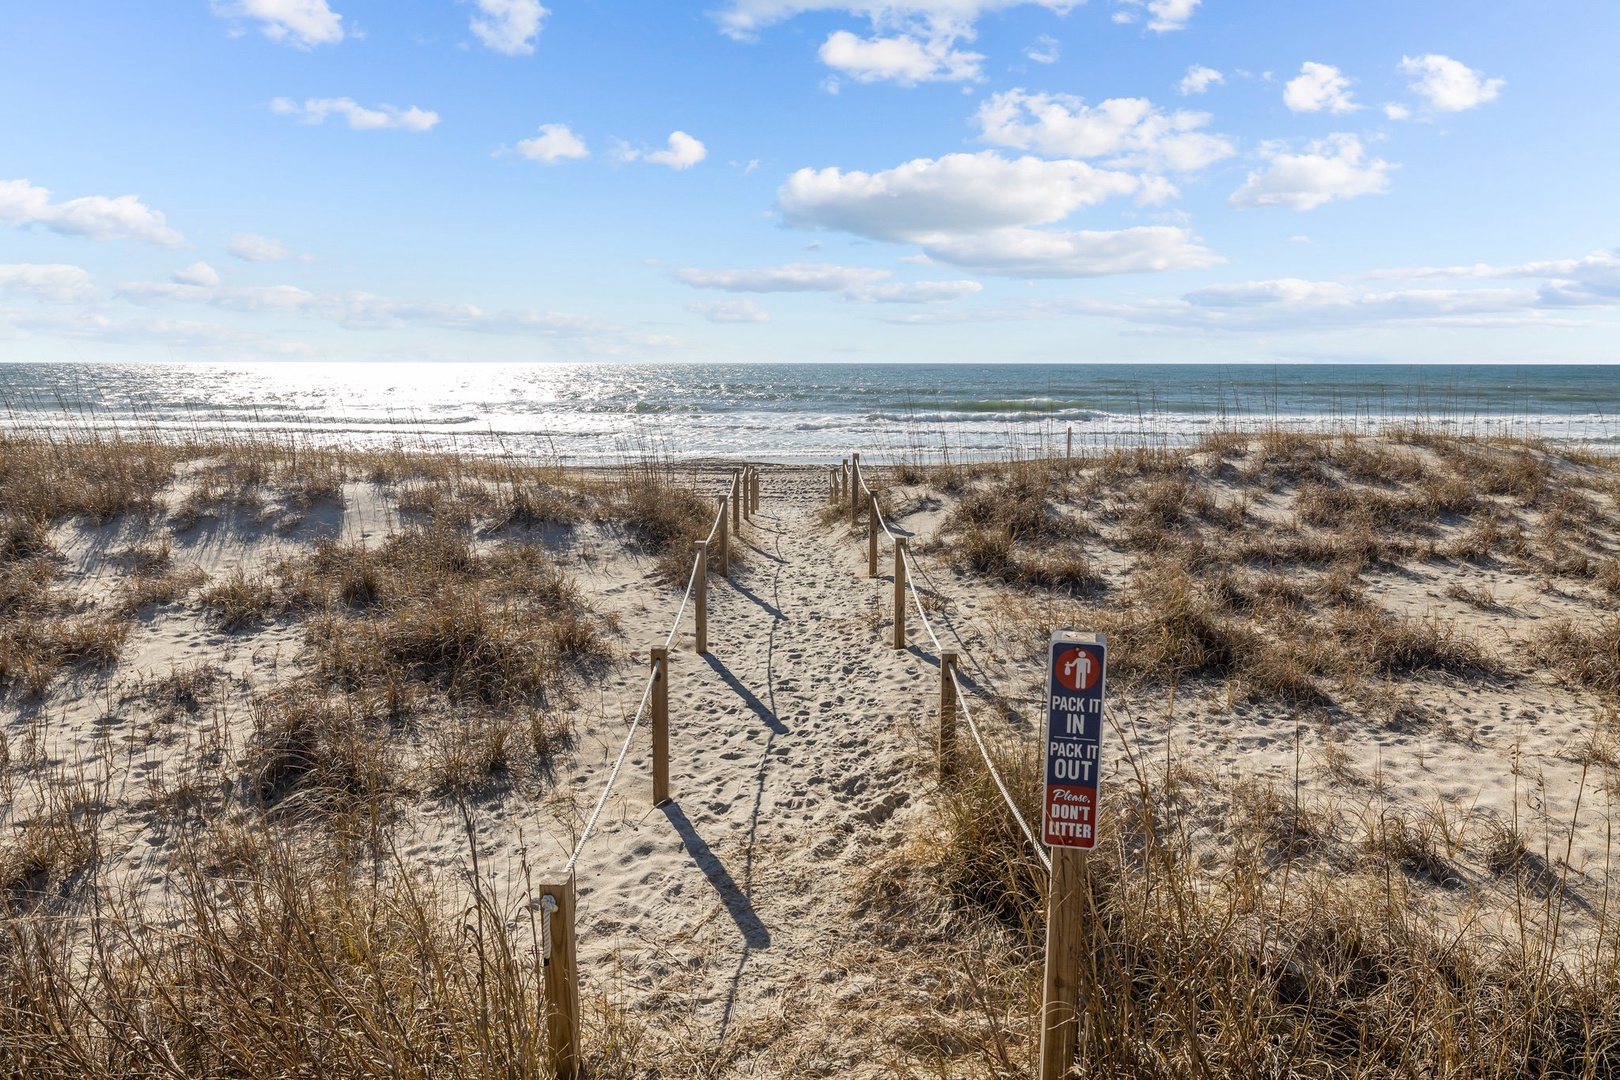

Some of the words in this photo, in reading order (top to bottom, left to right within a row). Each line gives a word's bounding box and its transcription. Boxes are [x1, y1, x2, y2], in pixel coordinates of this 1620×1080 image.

[1052, 695, 1085, 713] PACK
[1089, 698, 1101, 714] IT
[1066, 713, 1085, 735] IN
[1050, 741, 1083, 759] PACK
[1086, 744, 1099, 760] IT
[1054, 758, 1093, 781] OUT
[1051, 803, 1091, 821] DON'T
[1048, 820, 1092, 839] LITTER
